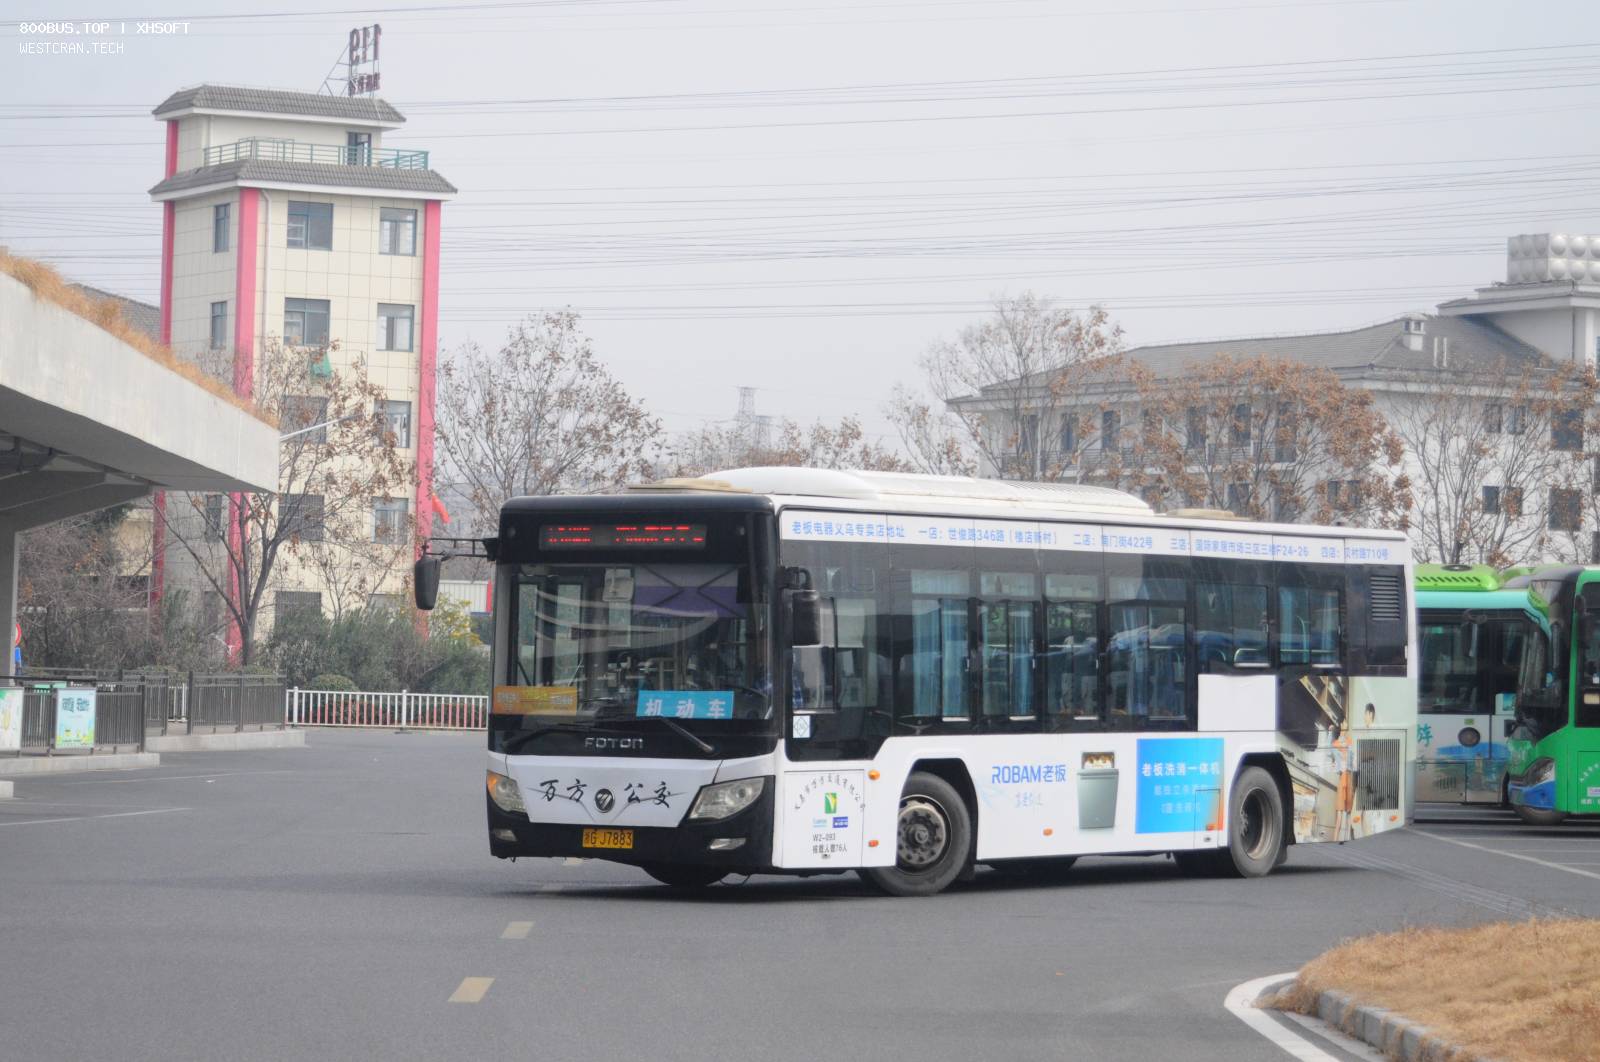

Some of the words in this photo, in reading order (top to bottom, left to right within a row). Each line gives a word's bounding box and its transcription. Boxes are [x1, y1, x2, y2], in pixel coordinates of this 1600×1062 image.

[645, 699, 726, 718] 机动车
[585, 737, 644, 749] FOTON
[540, 779, 588, 802] 万方
[624, 781, 673, 808] 公交
